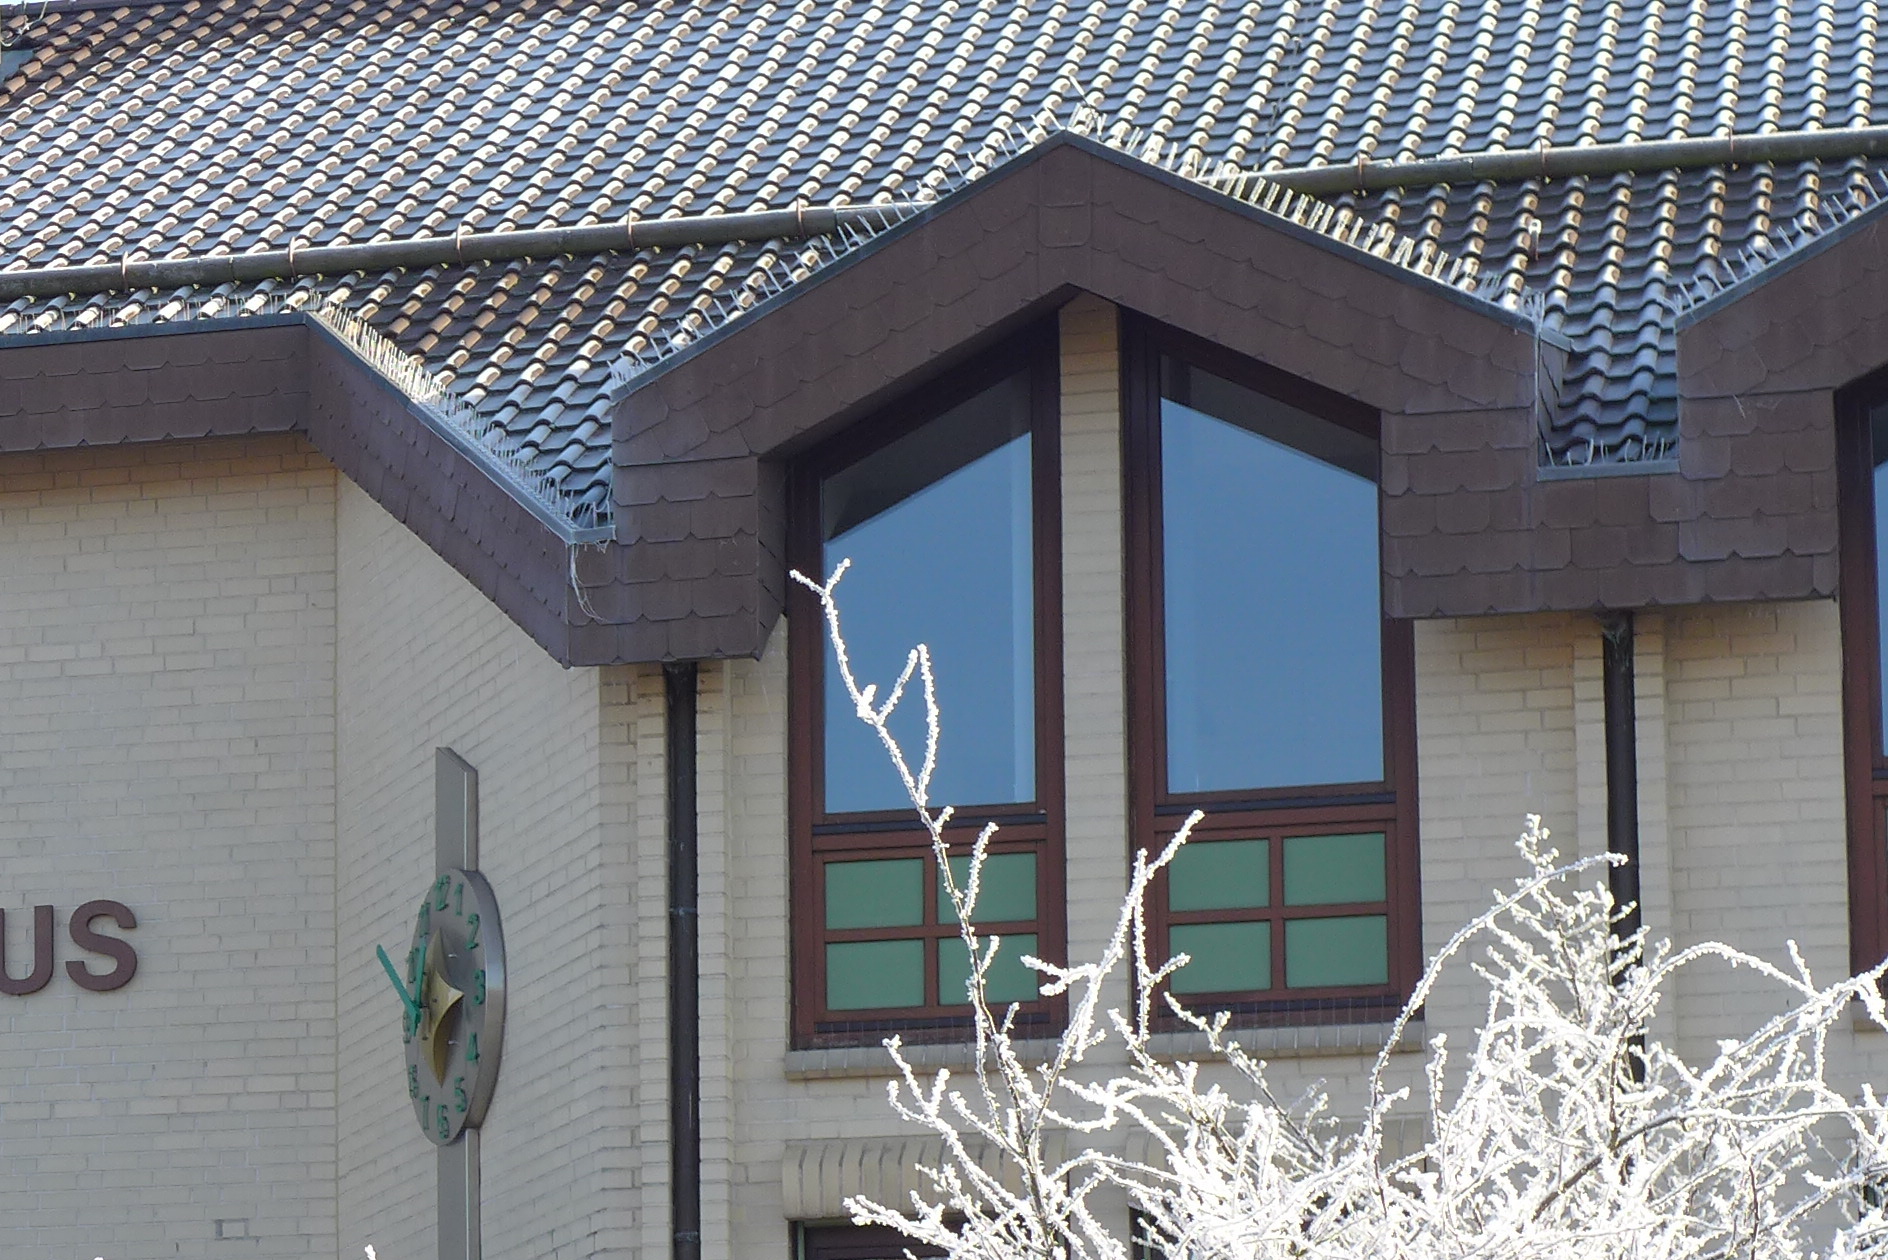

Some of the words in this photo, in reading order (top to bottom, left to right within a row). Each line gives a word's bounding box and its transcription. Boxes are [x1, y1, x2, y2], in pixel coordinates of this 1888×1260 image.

[455, 883, 464, 916] 1
[466, 913, 481, 951] 2
[473, 968, 487, 1006] 3
[466, 1031, 480, 1066] 4
[454, 1076, 468, 1113] 5
[437, 1103, 451, 1140] 6
